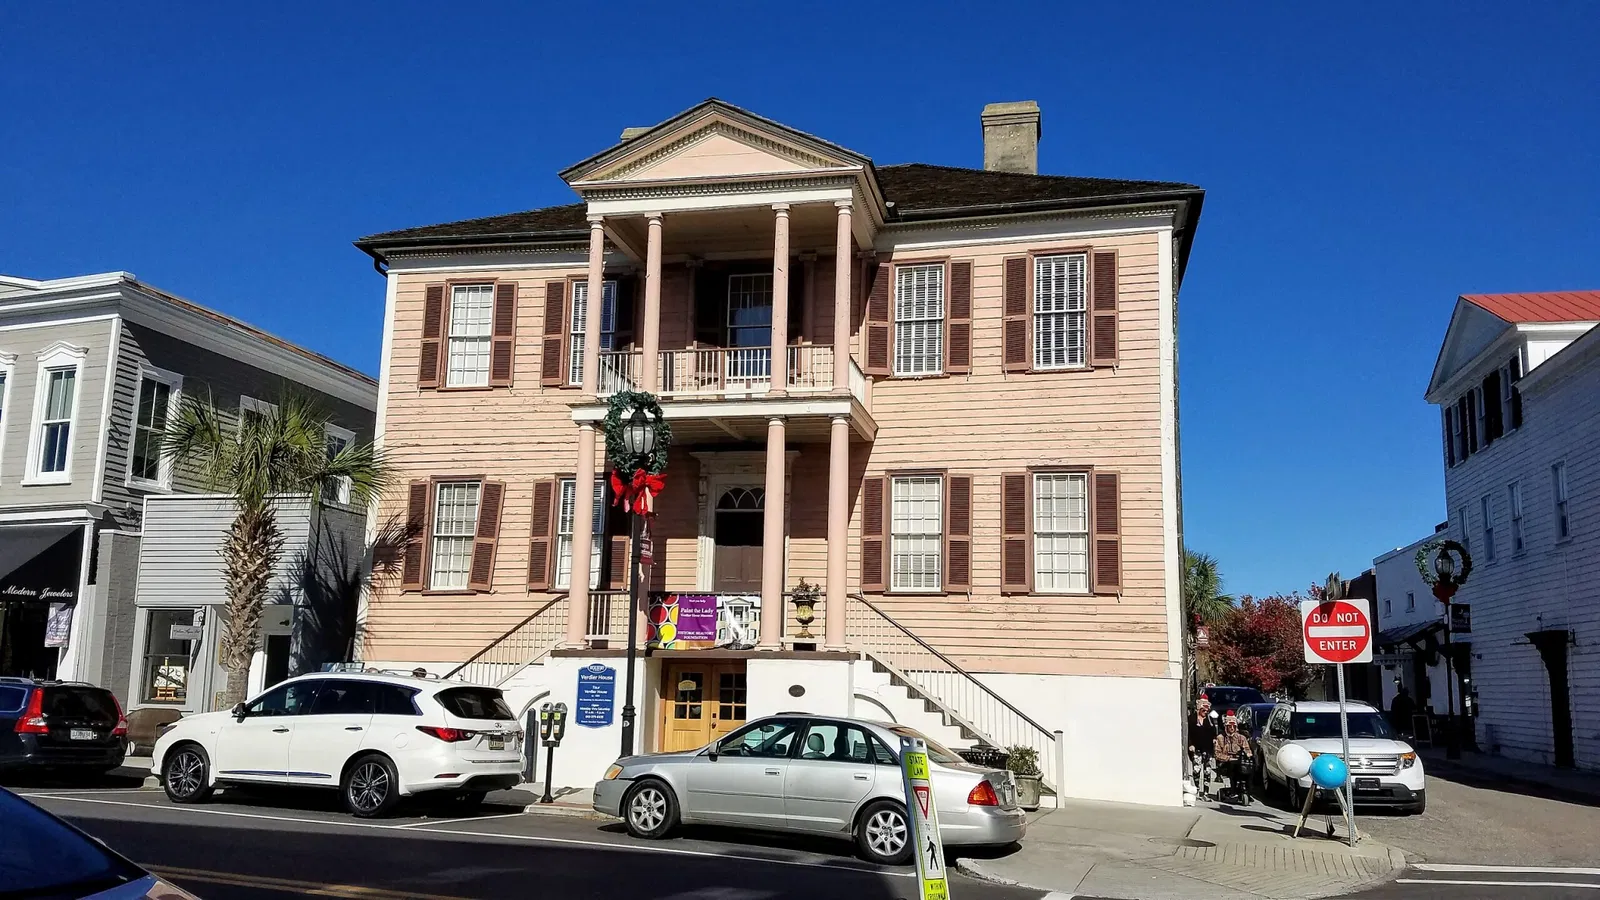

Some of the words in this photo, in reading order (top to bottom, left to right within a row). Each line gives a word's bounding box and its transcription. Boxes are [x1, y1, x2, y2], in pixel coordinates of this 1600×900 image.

[2, 585, 36, 596] Modern
[1313, 613, 1328, 623] DO
[1337, 612, 1359, 623] NOT
[1320, 640, 1357, 651] ENTER
[908, 755, 924, 766] STATE
[913, 768, 924, 776] LAW
